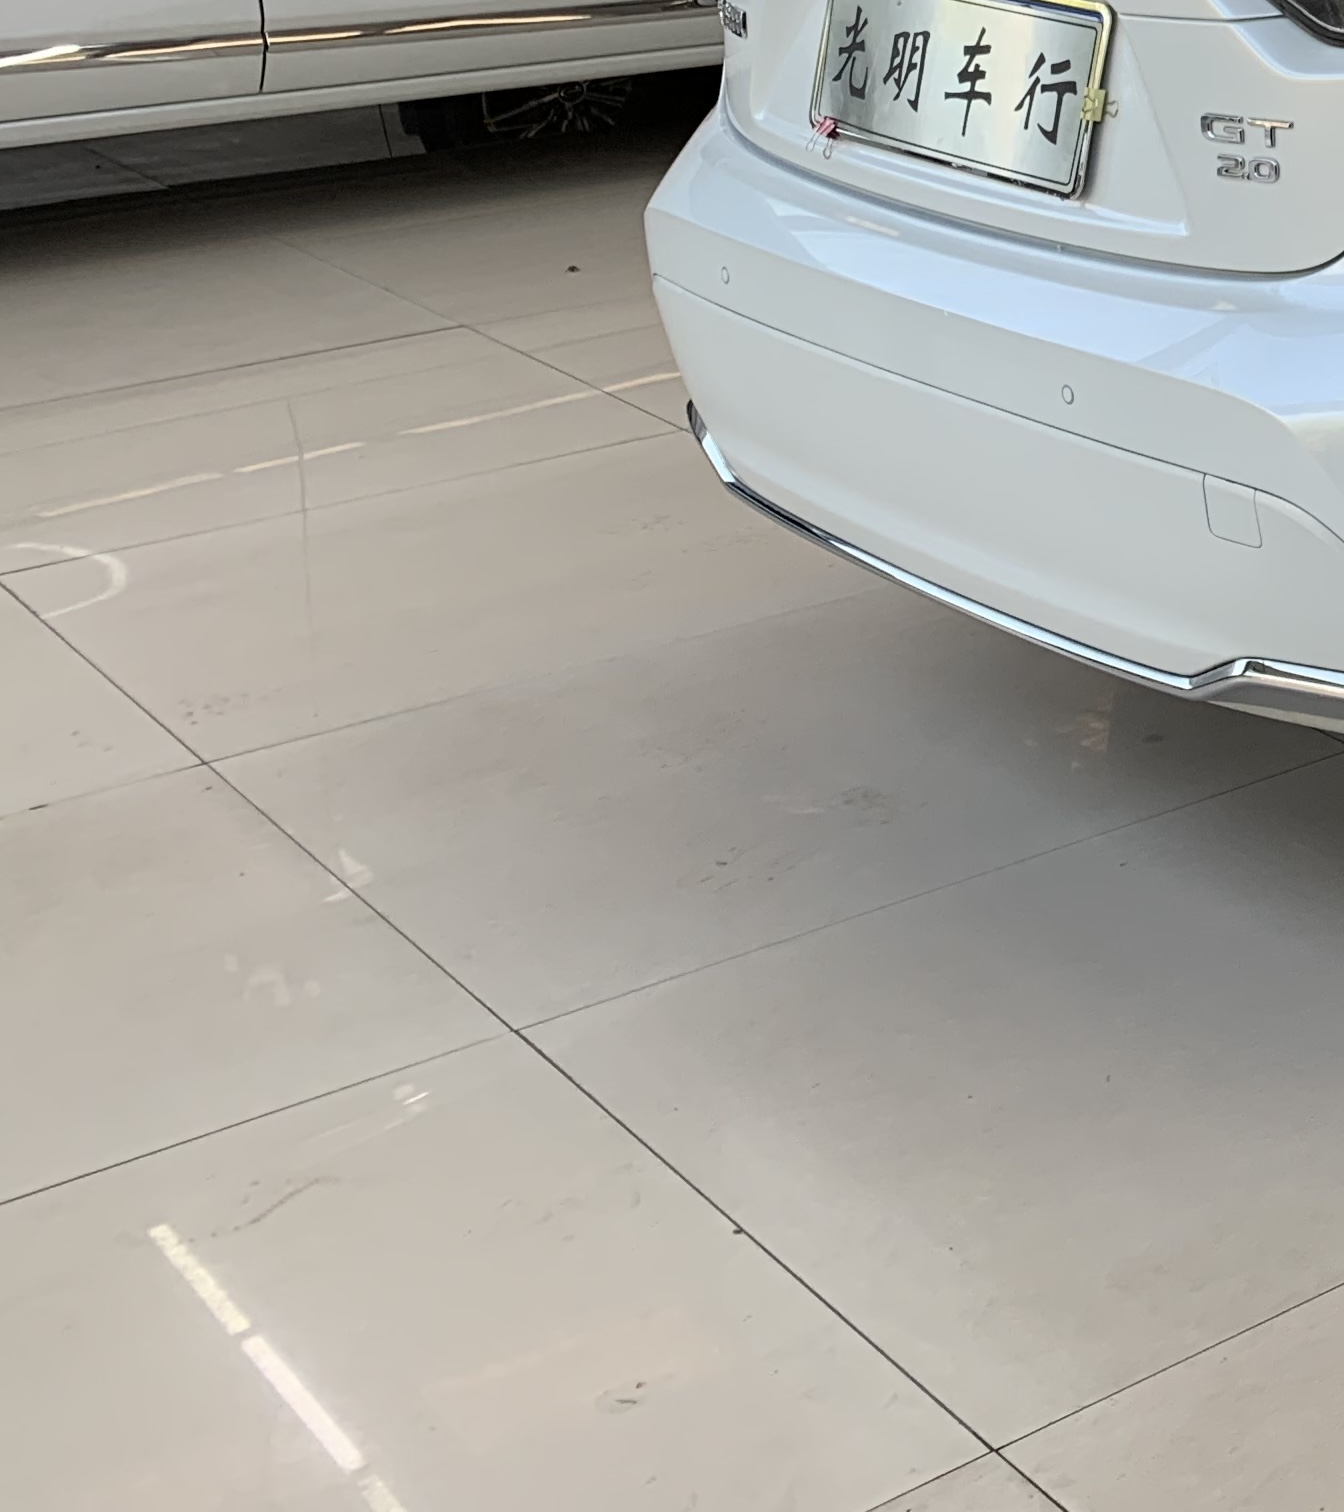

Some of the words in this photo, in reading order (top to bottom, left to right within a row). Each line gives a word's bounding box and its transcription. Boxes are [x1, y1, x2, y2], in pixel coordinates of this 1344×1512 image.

[832, 5, 1078, 145] 光明车行
[1200, 112, 1294, 147] GT
[1215, 153, 1281, 184] 2.0
